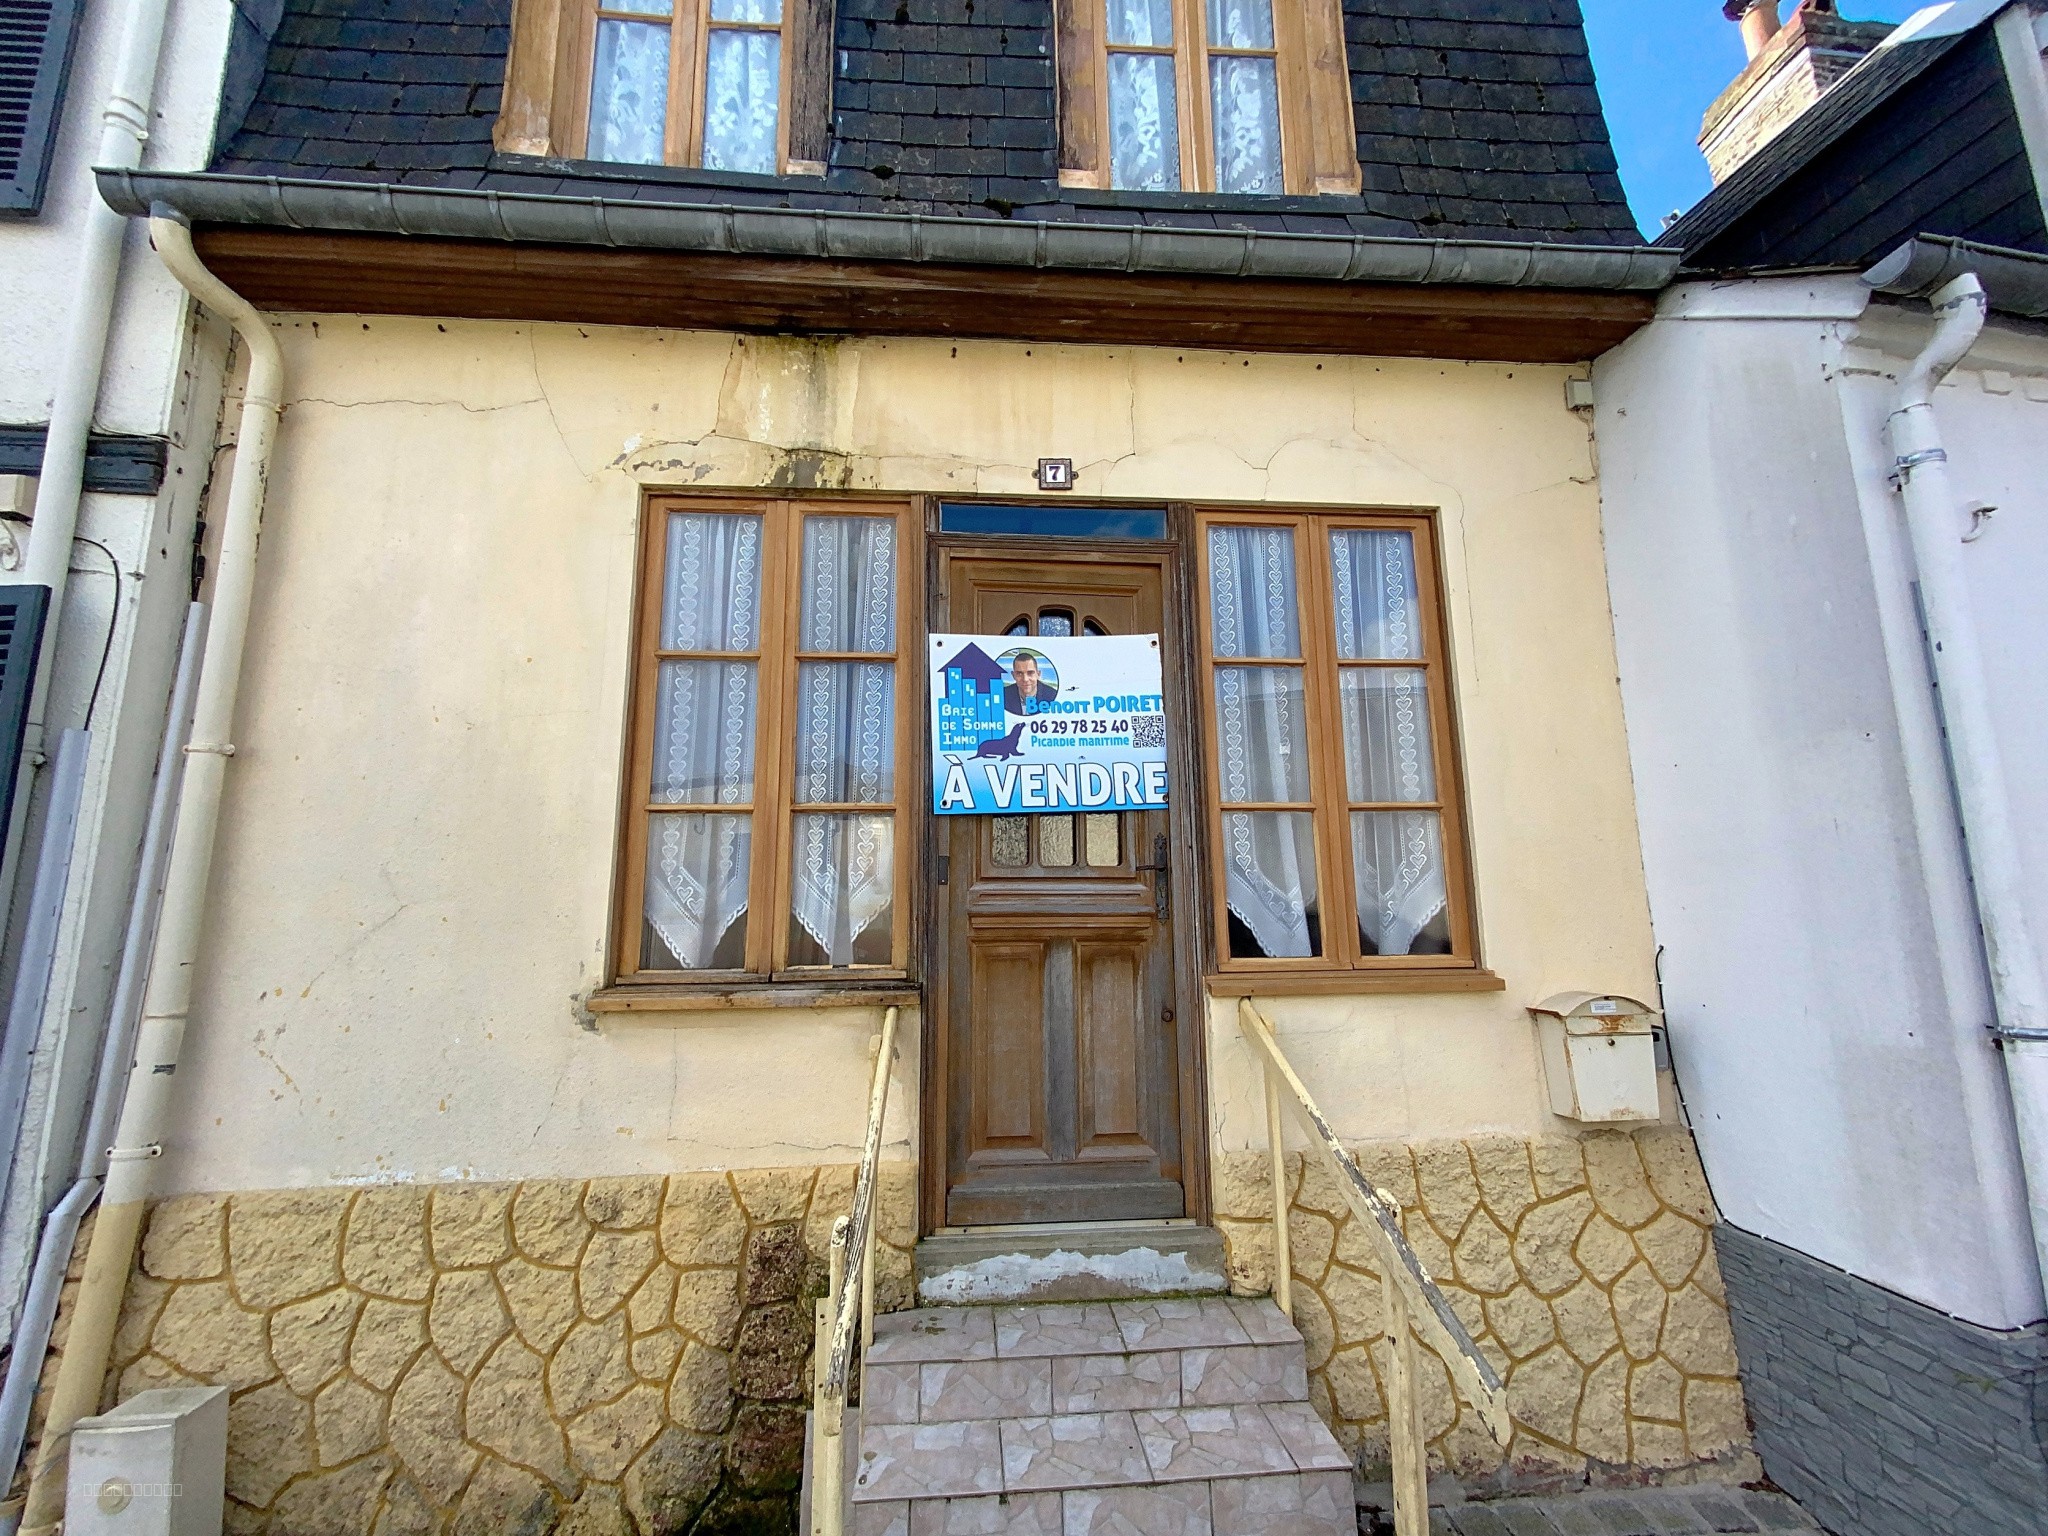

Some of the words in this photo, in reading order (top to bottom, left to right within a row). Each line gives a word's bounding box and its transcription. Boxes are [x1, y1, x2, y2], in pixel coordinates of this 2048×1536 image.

[1048, 465, 1061, 481] 7
[1094, 695, 1162, 713] POIRET
[1030, 720, 1048, 734] 06
[1051, 720, 1067, 734] 29
[1071, 720, 1088, 734] 78
[1091, 720, 1108, 733] 25
[1110, 719, 1128, 733] 40
[940, 754, 976, 809] À
[984, 761, 1168, 808] VENDRE
